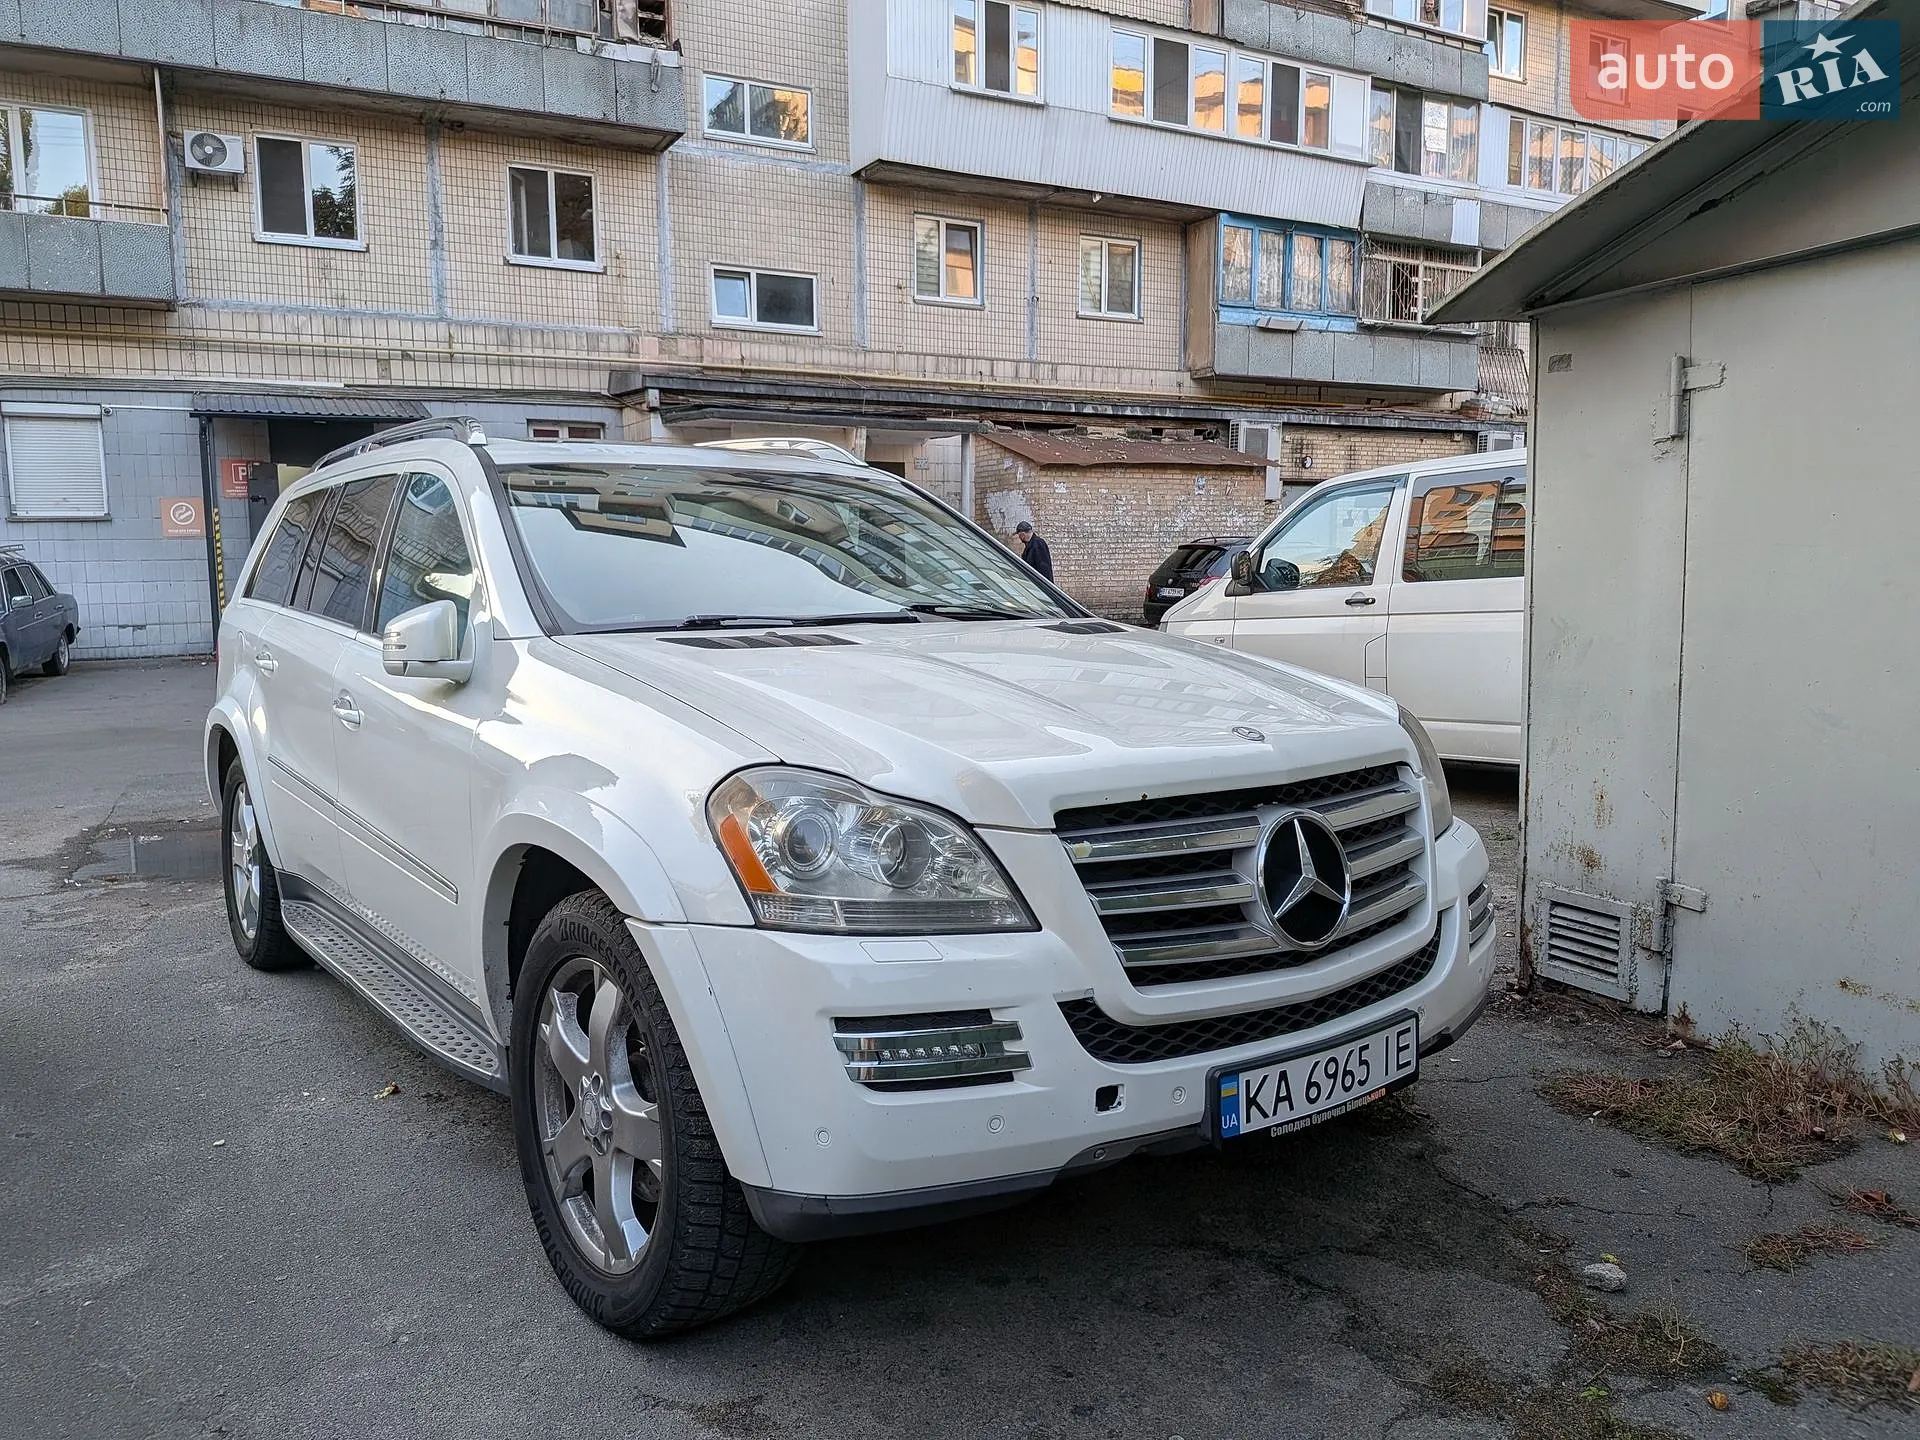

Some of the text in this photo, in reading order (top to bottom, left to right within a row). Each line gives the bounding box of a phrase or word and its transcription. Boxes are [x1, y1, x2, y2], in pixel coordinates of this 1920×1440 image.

[558, 917, 645, 1013] BRIDGESTONE
[1244, 1026, 1412, 1125] KA 6965 IE
[1221, 1114, 1239, 1130] UA
[1270, 1117, 1311, 1138] Солодка
[1311, 1104, 1346, 1125] булочка
